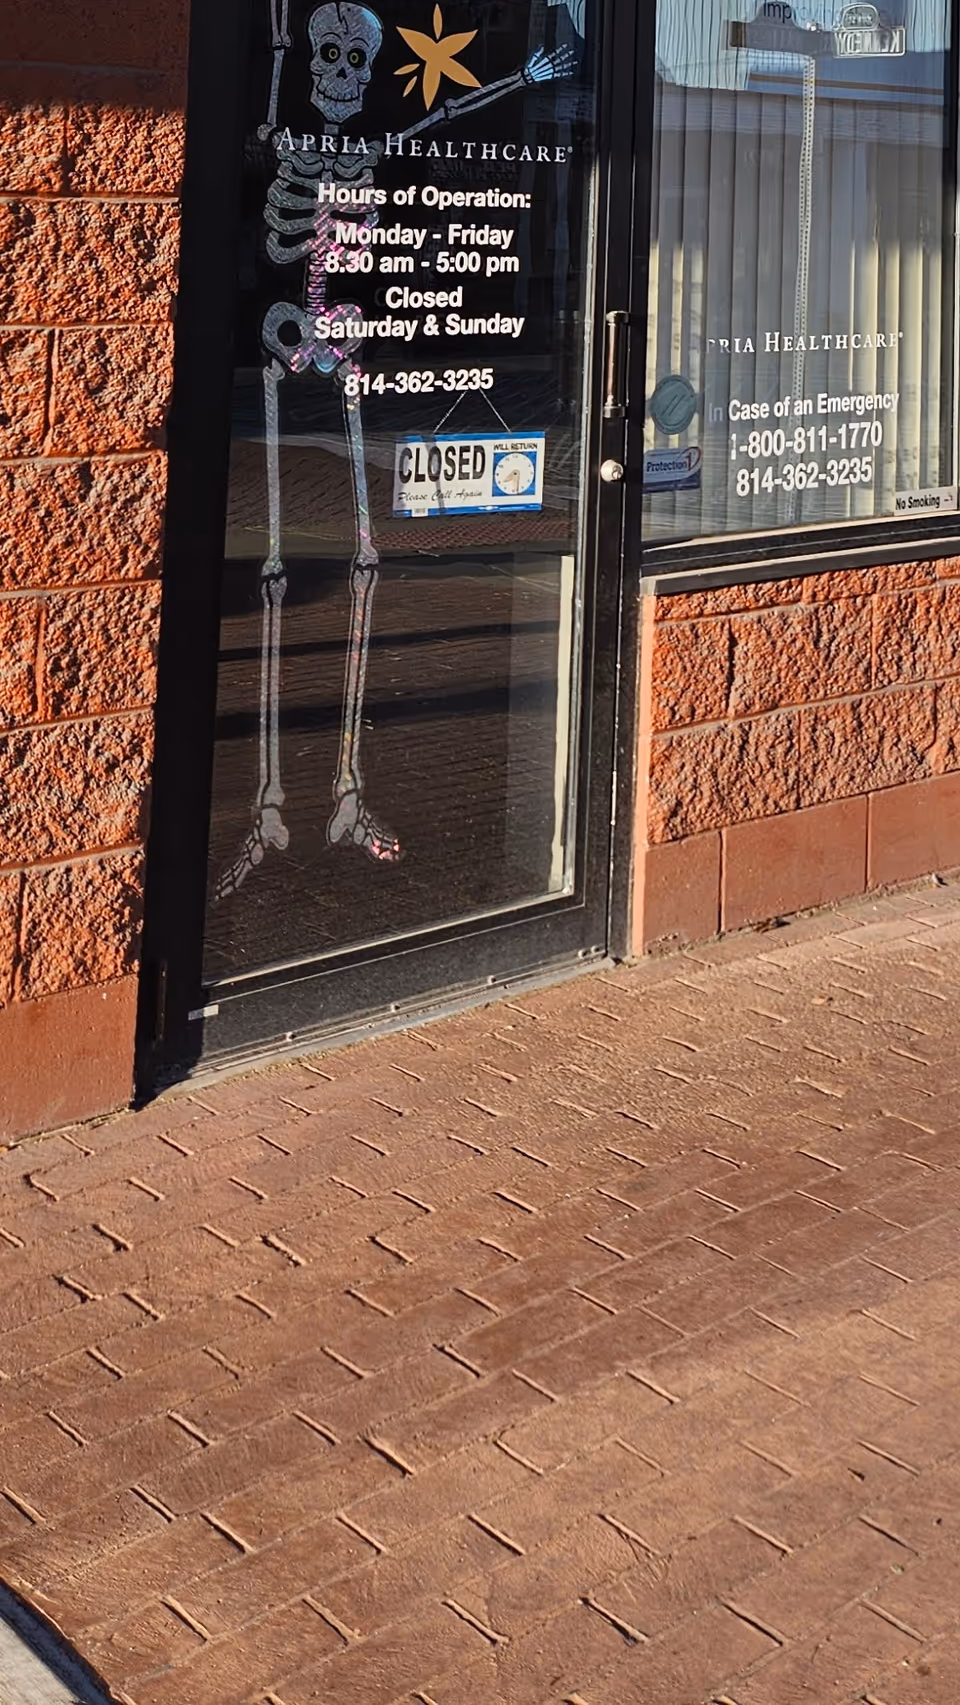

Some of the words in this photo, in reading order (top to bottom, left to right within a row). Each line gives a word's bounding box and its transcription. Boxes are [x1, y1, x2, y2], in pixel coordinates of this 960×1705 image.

[276, 127, 370, 154] APRIA
[318, 183, 387, 205] Hours
[393, 185, 416, 205] of
[421, 186, 531, 210] Operation:
[335, 223, 427, 249] Monday
[448, 224, 514, 249] Friday
[379, 257, 414, 273] am
[436, 251, 480, 273] 5:00
[485, 256, 520, 277] pm
[385, 286, 463, 309] Closed
[314, 315, 418, 342] Saturday
[423, 314, 440, 336] &
[445, 313, 525, 338] Sunday
[706, 336, 755, 353] PRIA
[344, 368, 494, 396] 814-362-3235
[728, 399, 769, 422] Case
[774, 396, 790, 416] of
[794, 397, 813, 415] an
[817, 392, 900, 415] Emergency
[493, 443, 509, 451] WILL
[730, 421, 883, 460] 1-800-811-1770
[399, 445, 486, 483] CLOSED
[736, 456, 873, 497] 814-362-3235
[397, 490, 428, 503] Please
[431, 489, 451, 502] Call
[455, 488, 483, 502] Again
[895, 497, 906, 510] No
[907, 494, 941, 509] Smoking
